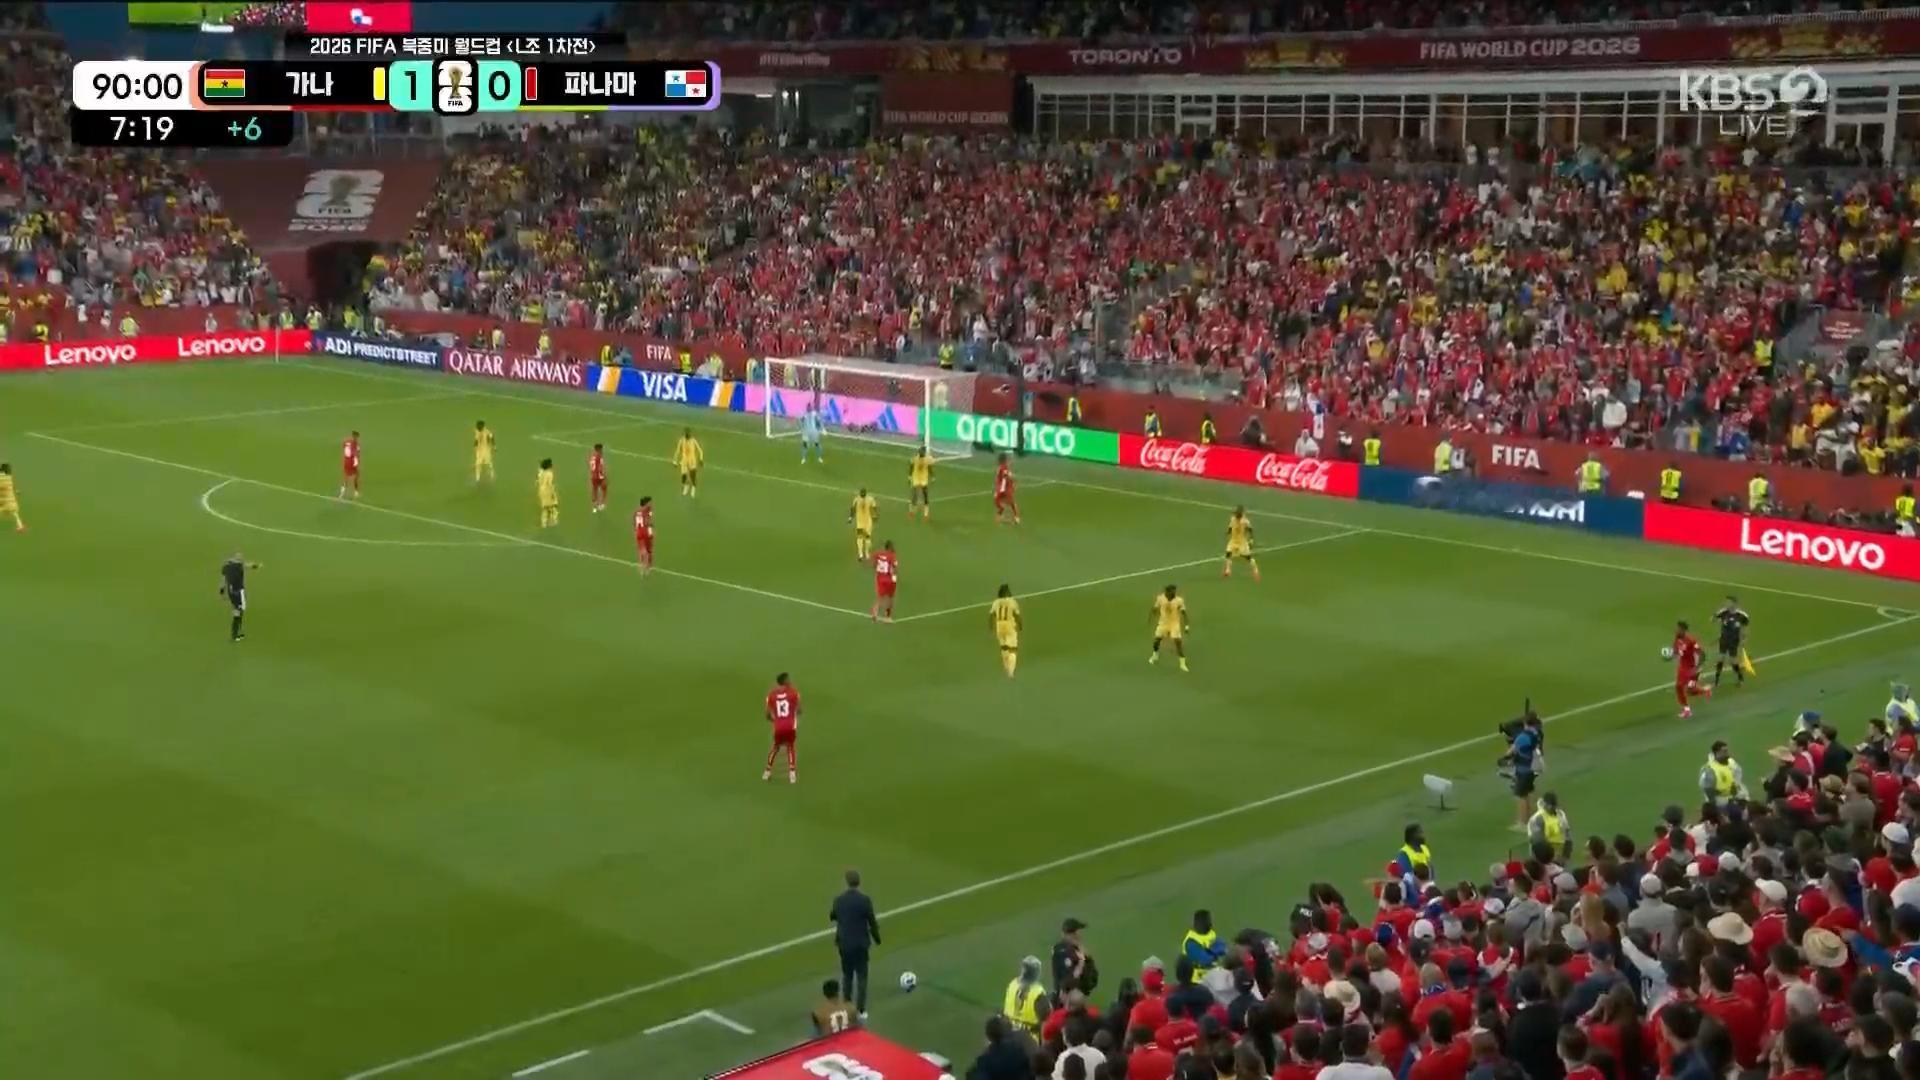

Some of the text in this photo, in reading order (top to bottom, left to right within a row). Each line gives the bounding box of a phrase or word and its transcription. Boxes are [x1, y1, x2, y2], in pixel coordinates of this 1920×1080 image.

[1069, 48, 1182, 64] TORONTO
[1420, 37, 1640, 59] FIFA WORLD CUP 2026
[44, 343, 136, 365] Lenovo
[178, 336, 265, 357] Lenovo
[325, 337, 351, 355] ADI
[646, 344, 672, 361] FIFA
[450, 350, 582, 384] QATAR AIRWAYS
[641, 371, 688, 401] VISA
[956, 412, 1075, 455] aramco
[1491, 444, 1541, 469] FIFA
[1741, 518, 1885, 570] Lenovo
[776, 699, 790, 717] 13
